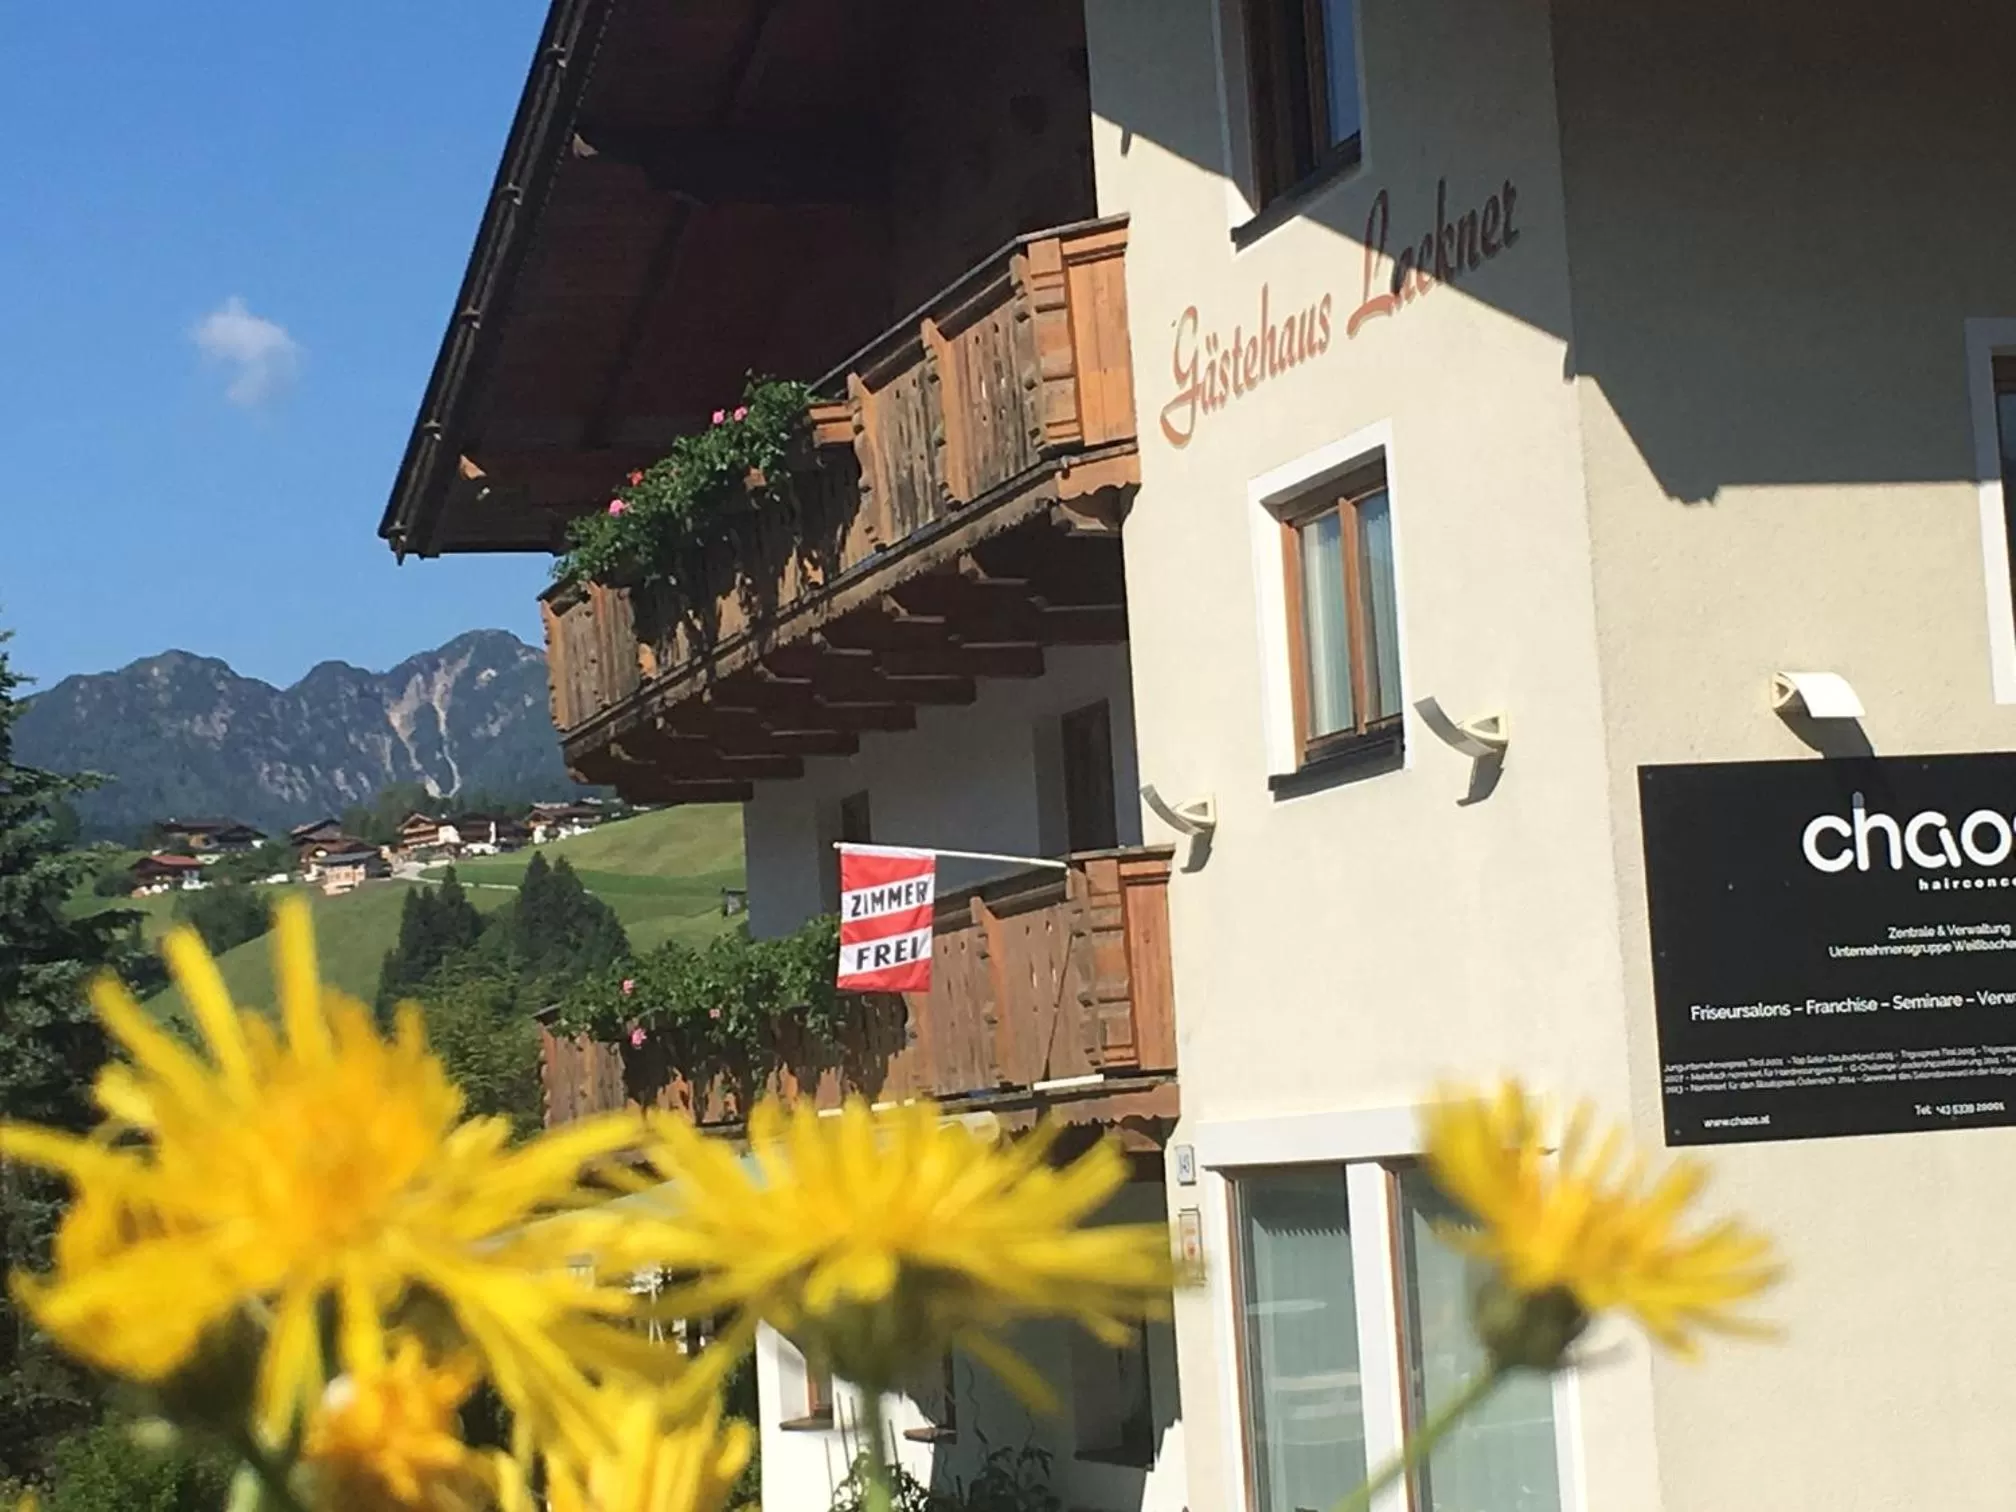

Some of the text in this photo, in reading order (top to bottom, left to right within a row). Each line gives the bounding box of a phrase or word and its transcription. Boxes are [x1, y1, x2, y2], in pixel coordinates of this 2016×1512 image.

[1160, 178, 1520, 449] Gästehaus Lackner
[1802, 791, 2016, 873] chao
[851, 880, 929, 918] ZIMMER
[1887, 922, 2011, 939] Zentrale & Verwaltung
[856, 936, 919, 971] FREI
[1690, 1002, 1791, 1021] Friseursalons
[1806, 996, 1878, 1015] Franchise
[1893, 993, 1963, 1010] Seminare
